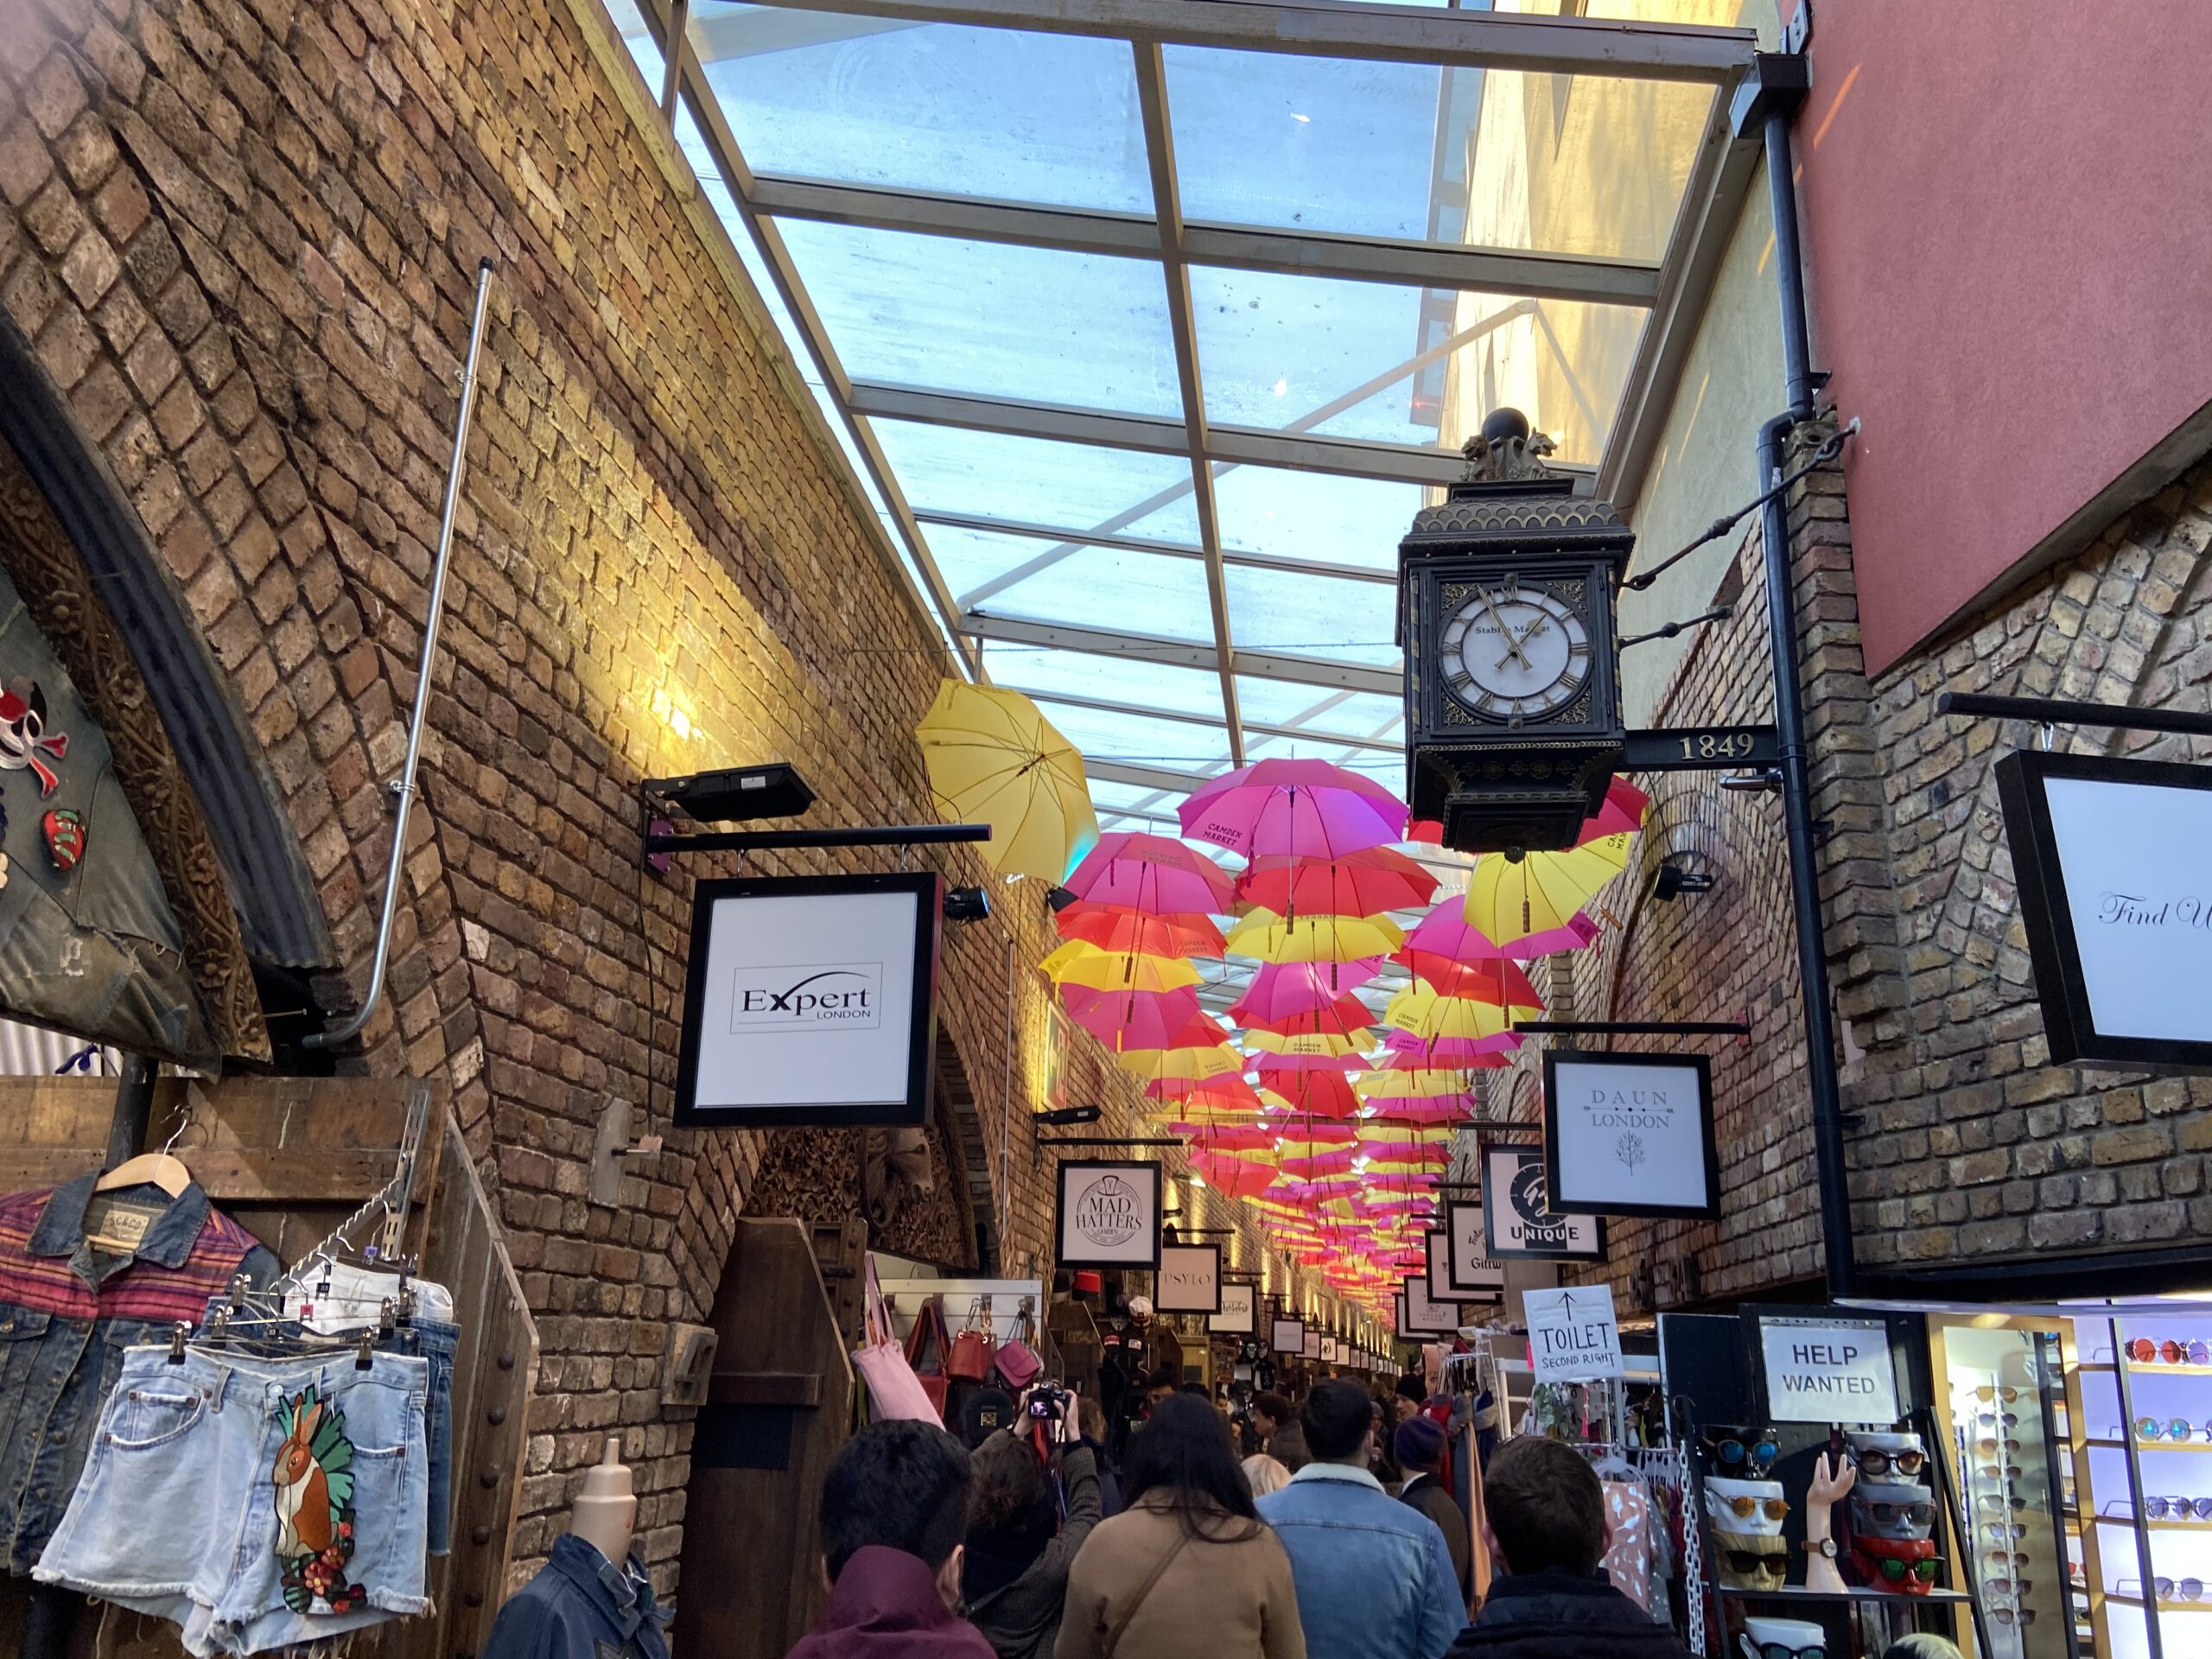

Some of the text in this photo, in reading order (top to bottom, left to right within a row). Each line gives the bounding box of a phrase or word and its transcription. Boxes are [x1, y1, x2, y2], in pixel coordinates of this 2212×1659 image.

[1679, 733, 1755, 760] 1849
[1202, 830, 1236, 846] MARKET
[1208, 823, 1243, 839] CAMDEN
[2098, 891, 2169, 926] Find
[740, 988, 872, 1017] Expert
[817, 1009, 871, 1020] LONDON
[1591, 1090, 1668, 1105] DAUN
[1592, 1113, 1669, 1129] LONDON
[1090, 1197, 1131, 1213] MAD
[1076, 1213, 1142, 1230] HATTERS
[1510, 1226, 1580, 1242] UNIQUE
[1538, 1323, 1610, 1353] TOILET
[1541, 1352, 1615, 1369] SECOND RIGHT
[1792, 1344, 1858, 1365] HELP
[1783, 1375, 1875, 1394] WANTED
